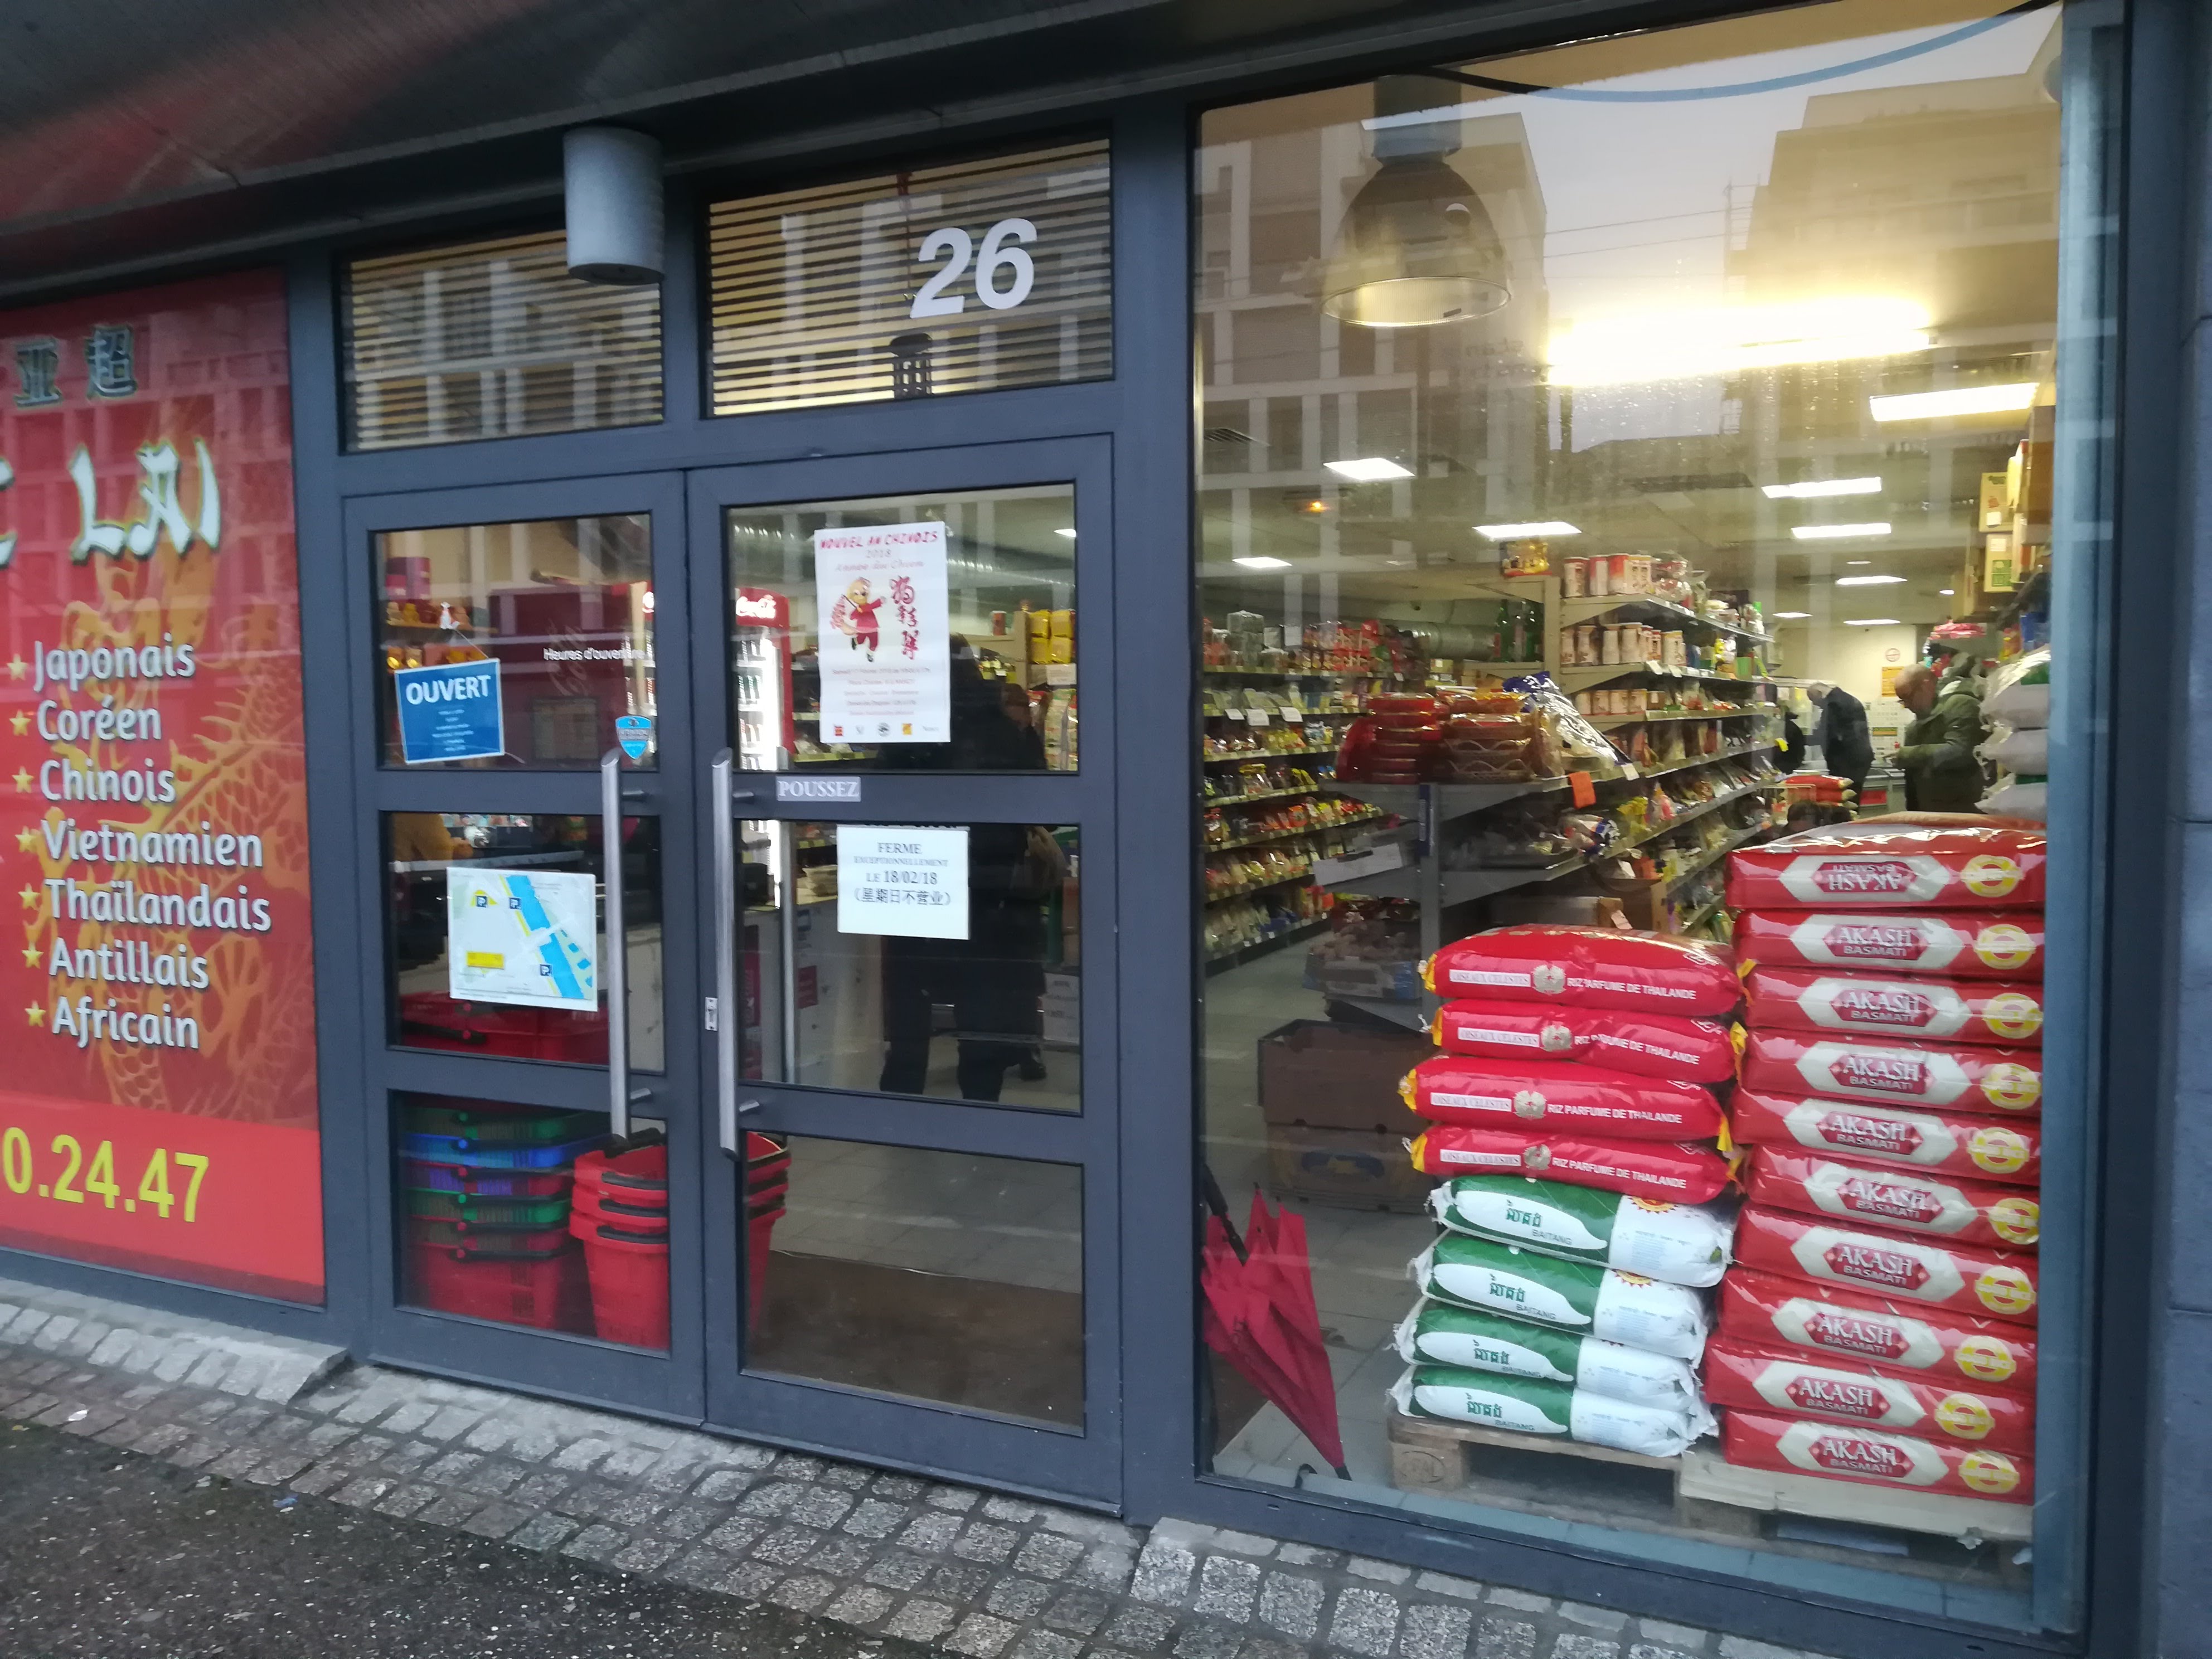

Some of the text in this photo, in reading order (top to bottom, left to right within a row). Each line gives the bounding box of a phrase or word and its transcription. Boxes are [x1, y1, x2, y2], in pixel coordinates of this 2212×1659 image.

[910, 218, 1038, 319] 26
[33, 633, 196, 692] Japonais
[406, 675, 491, 705] OUVERT
[37, 695, 162, 741] Coréen
[40, 758, 176, 802] Chinois
[778, 780, 860, 797] POUSSEZ
[41, 818, 263, 867] Vietnamien
[877, 842, 922, 855] FERME
[866, 872, 880, 882] LE
[1828, 873, 1903, 891] AKASH
[44, 878, 273, 932] Thaïlandais
[1836, 927, 1913, 947] AKASH
[1844, 945, 1907, 957] BASMATI
[48, 938, 210, 989] Antillais
[1567, 977, 1583, 987] RIZ
[1626, 983, 1641, 993] DE
[1844, 991, 1920, 1013] AKASH
[52, 996, 200, 1049] Africain
[1574, 1036, 1590, 1045] RIZ
[1629, 1040, 1645, 1052] DE
[1842, 1057, 1919, 1082] AKASH
[1849, 1075, 1914, 1090] BASMATI
[1547, 1104, 1564, 1114] RIZ
[1564, 1104, 1612, 1118] PARFUME
[1612, 1108, 1627, 1119] DE
[1831, 1115, 1905, 1142] AKASH
[1837, 1133, 1901, 1151] BASMATI
[2, 1126, 209, 1223] 0.24.47
[1551, 1157, 1569, 1168] RIZ
[1569, 1160, 1616, 1176] PARFUME
[1616, 1168, 1631, 1179] DE
[1848, 1181, 1927, 1210] AKASH
[1855, 1200, 1920, 1219] BASMATI
[1837, 1246, 1913, 1277] AKASH
[1843, 1265, 1907, 1286] BASMATI
[1816, 1316, 1893, 1346] AKASH
[1823, 1335, 1887, 1355] BASMATI
[1799, 1379, 1873, 1407] AKASH
[1806, 1398, 1868, 1415] BASMATI
[1822, 1439, 1897, 1466] AKASH
[1830, 1458, 1894, 1473] BASMATI
